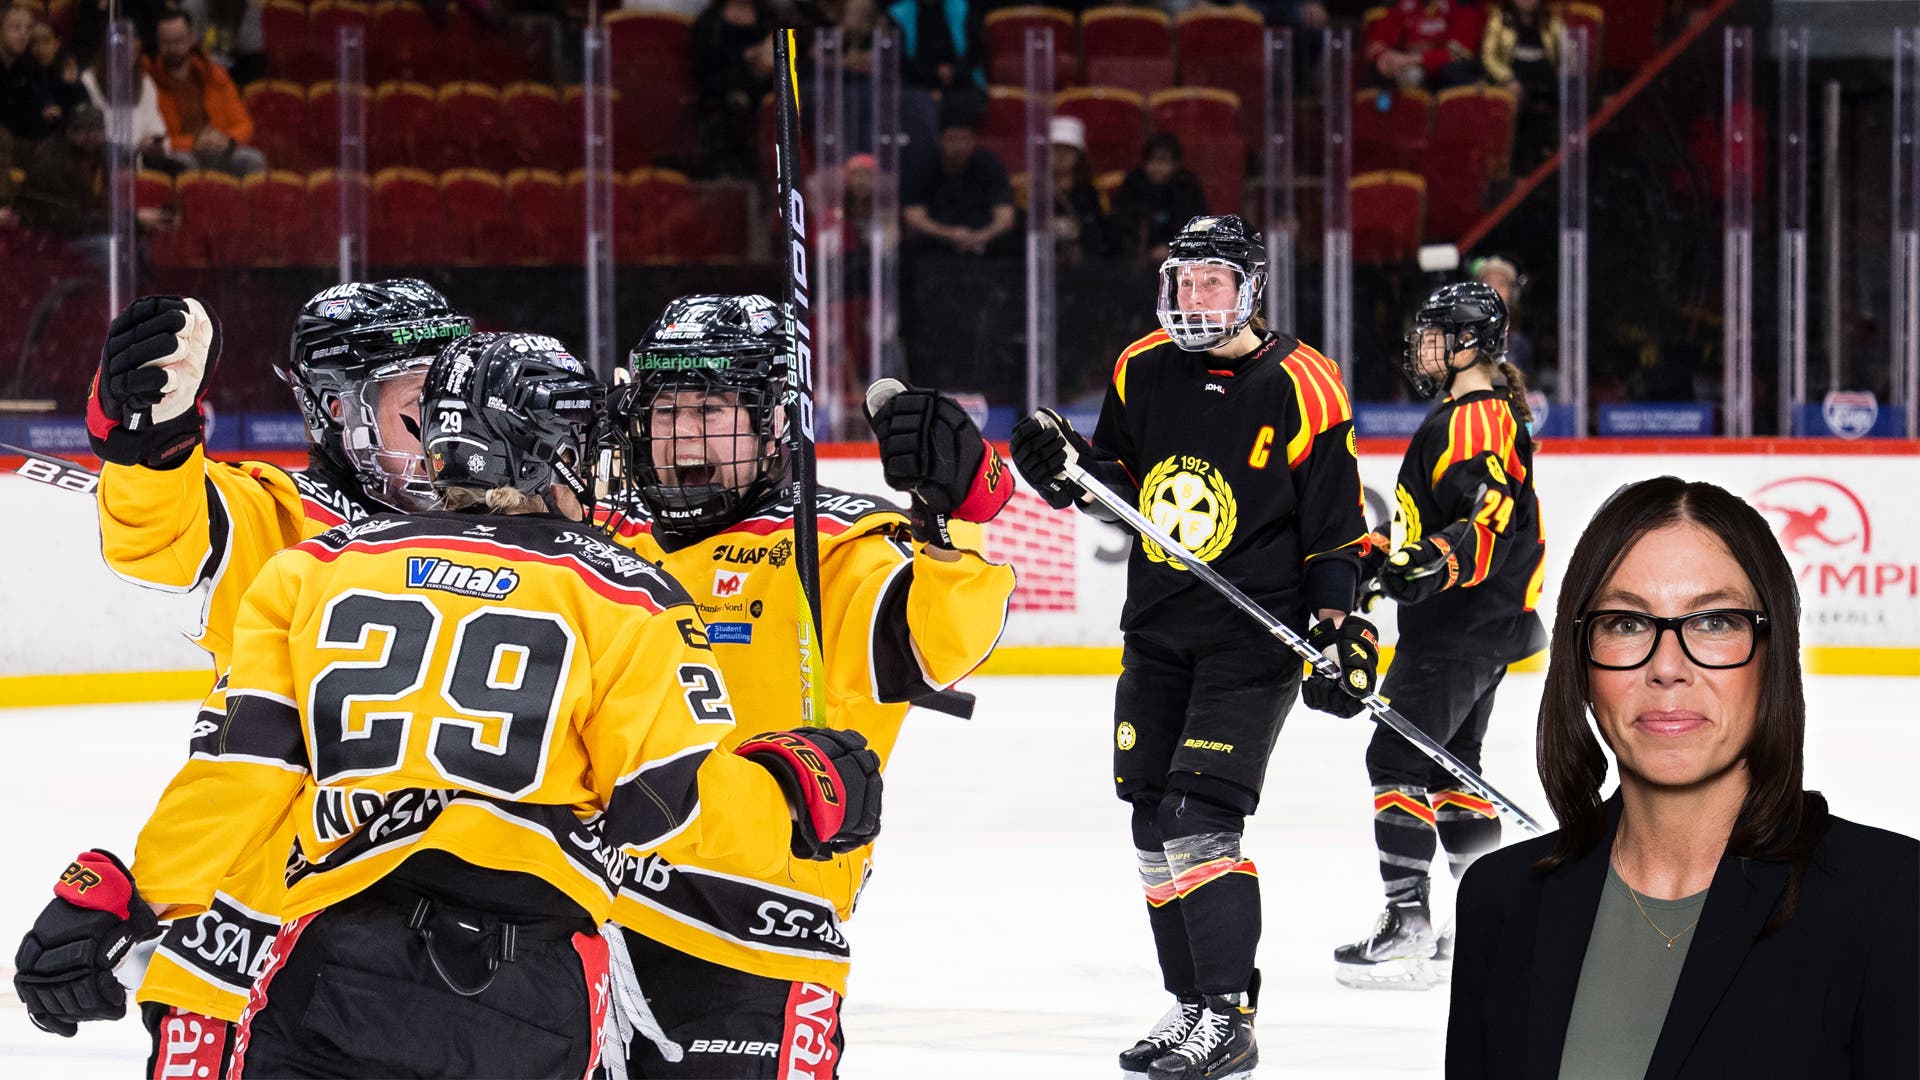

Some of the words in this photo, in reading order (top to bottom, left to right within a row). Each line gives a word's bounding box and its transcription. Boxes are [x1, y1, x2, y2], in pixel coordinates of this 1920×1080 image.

[786, 302, 797, 389] BAUER
[555, 399, 592, 409] BAUER
[438, 411, 462, 433] 29
[1249, 426, 1274, 469] C
[555, 460, 585, 493] BAUER
[1180, 455, 1210, 476] 1912
[1475, 489, 1515, 534] 24
[408, 557, 519, 595] Vinab
[714, 624, 742, 633] Student
[714, 632, 750, 642] Consulting
[800, 622, 813, 721] SYNC
[307, 591, 577, 801] 29
[1183, 738, 1234, 754] BAUER
[688, 1039, 780, 1058] BAUER
